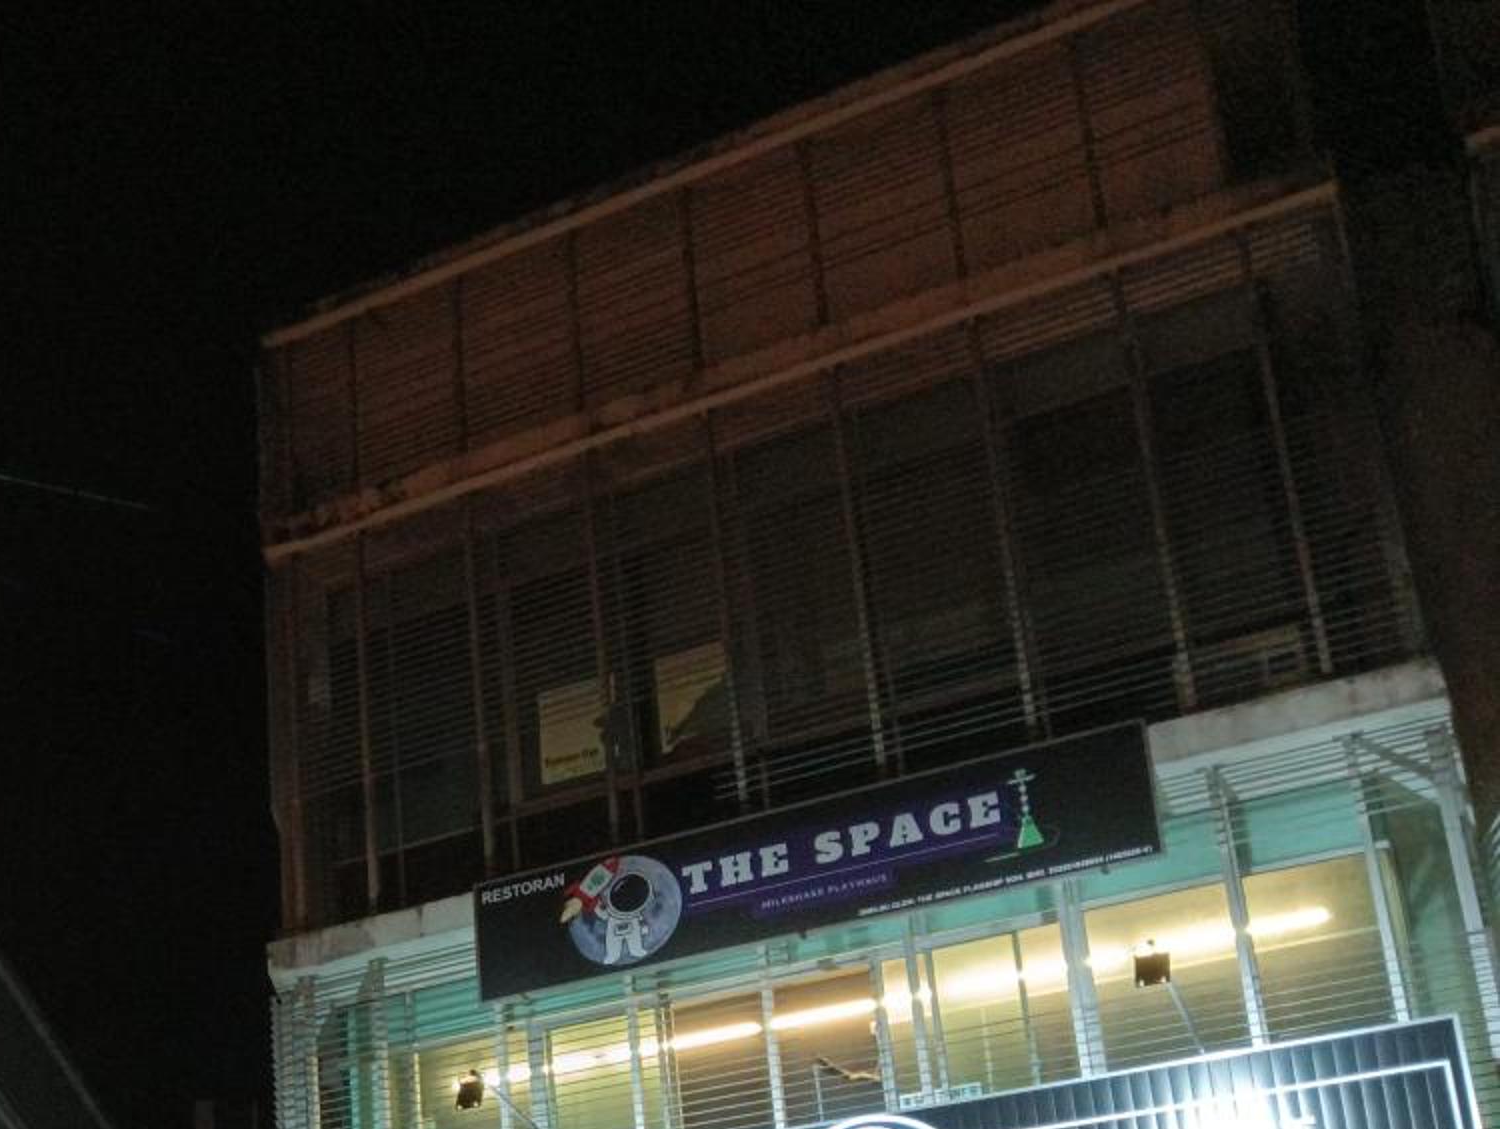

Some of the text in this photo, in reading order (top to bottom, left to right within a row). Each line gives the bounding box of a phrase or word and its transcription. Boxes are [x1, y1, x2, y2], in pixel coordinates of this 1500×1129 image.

[682, 842, 789, 894] THE
[814, 791, 1000, 864] SPACE
[481, 872, 565, 905] RESTORAN
